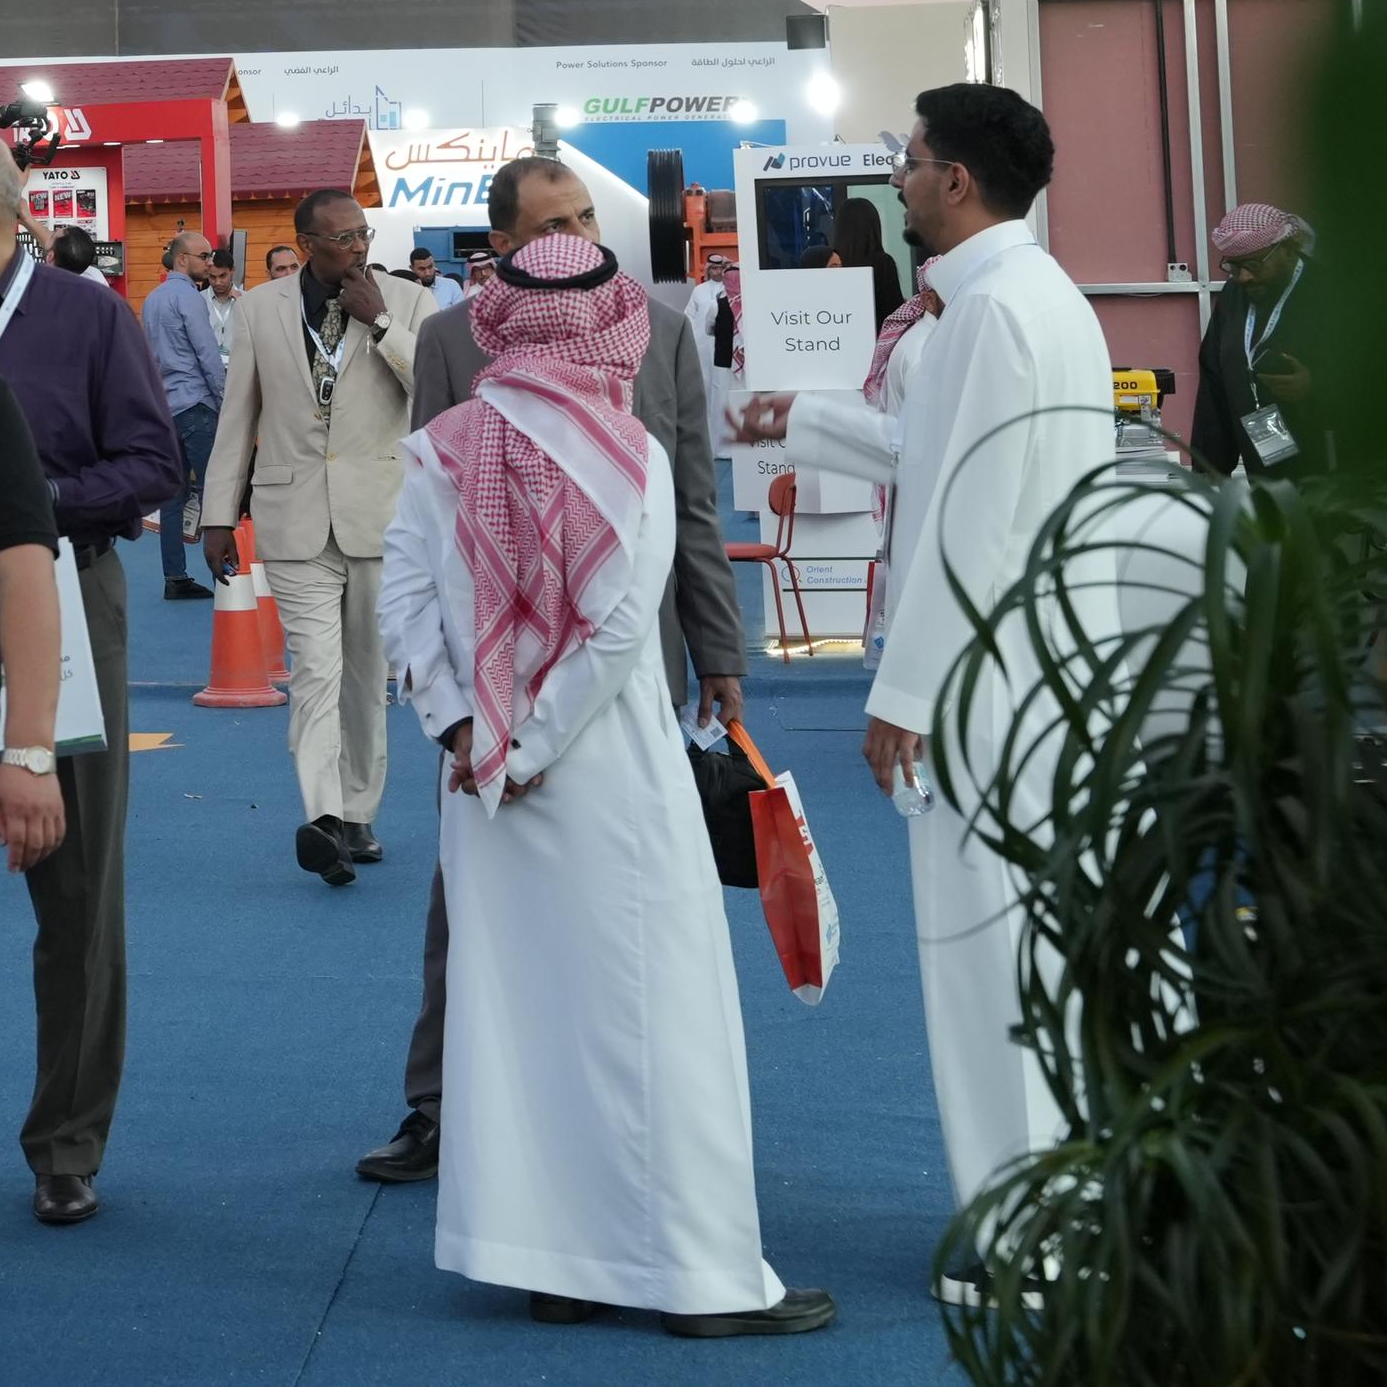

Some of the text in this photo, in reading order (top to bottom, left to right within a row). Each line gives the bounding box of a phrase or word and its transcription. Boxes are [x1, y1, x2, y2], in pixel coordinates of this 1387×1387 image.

[555, 59, 668, 69] Power Solutions Sponsor
[237, 67, 262, 75] onsor
[789, 153, 895, 171] provue Elec
[42, 171, 69, 180] YATO
[53, 190, 72, 201] NEW
[388, 174, 494, 208] MinE
[771, 310, 852, 326] Visit Our
[785, 336, 841, 352] Stand
[806, 564, 833, 574] Orient
[806, 575, 863, 584] Construction
